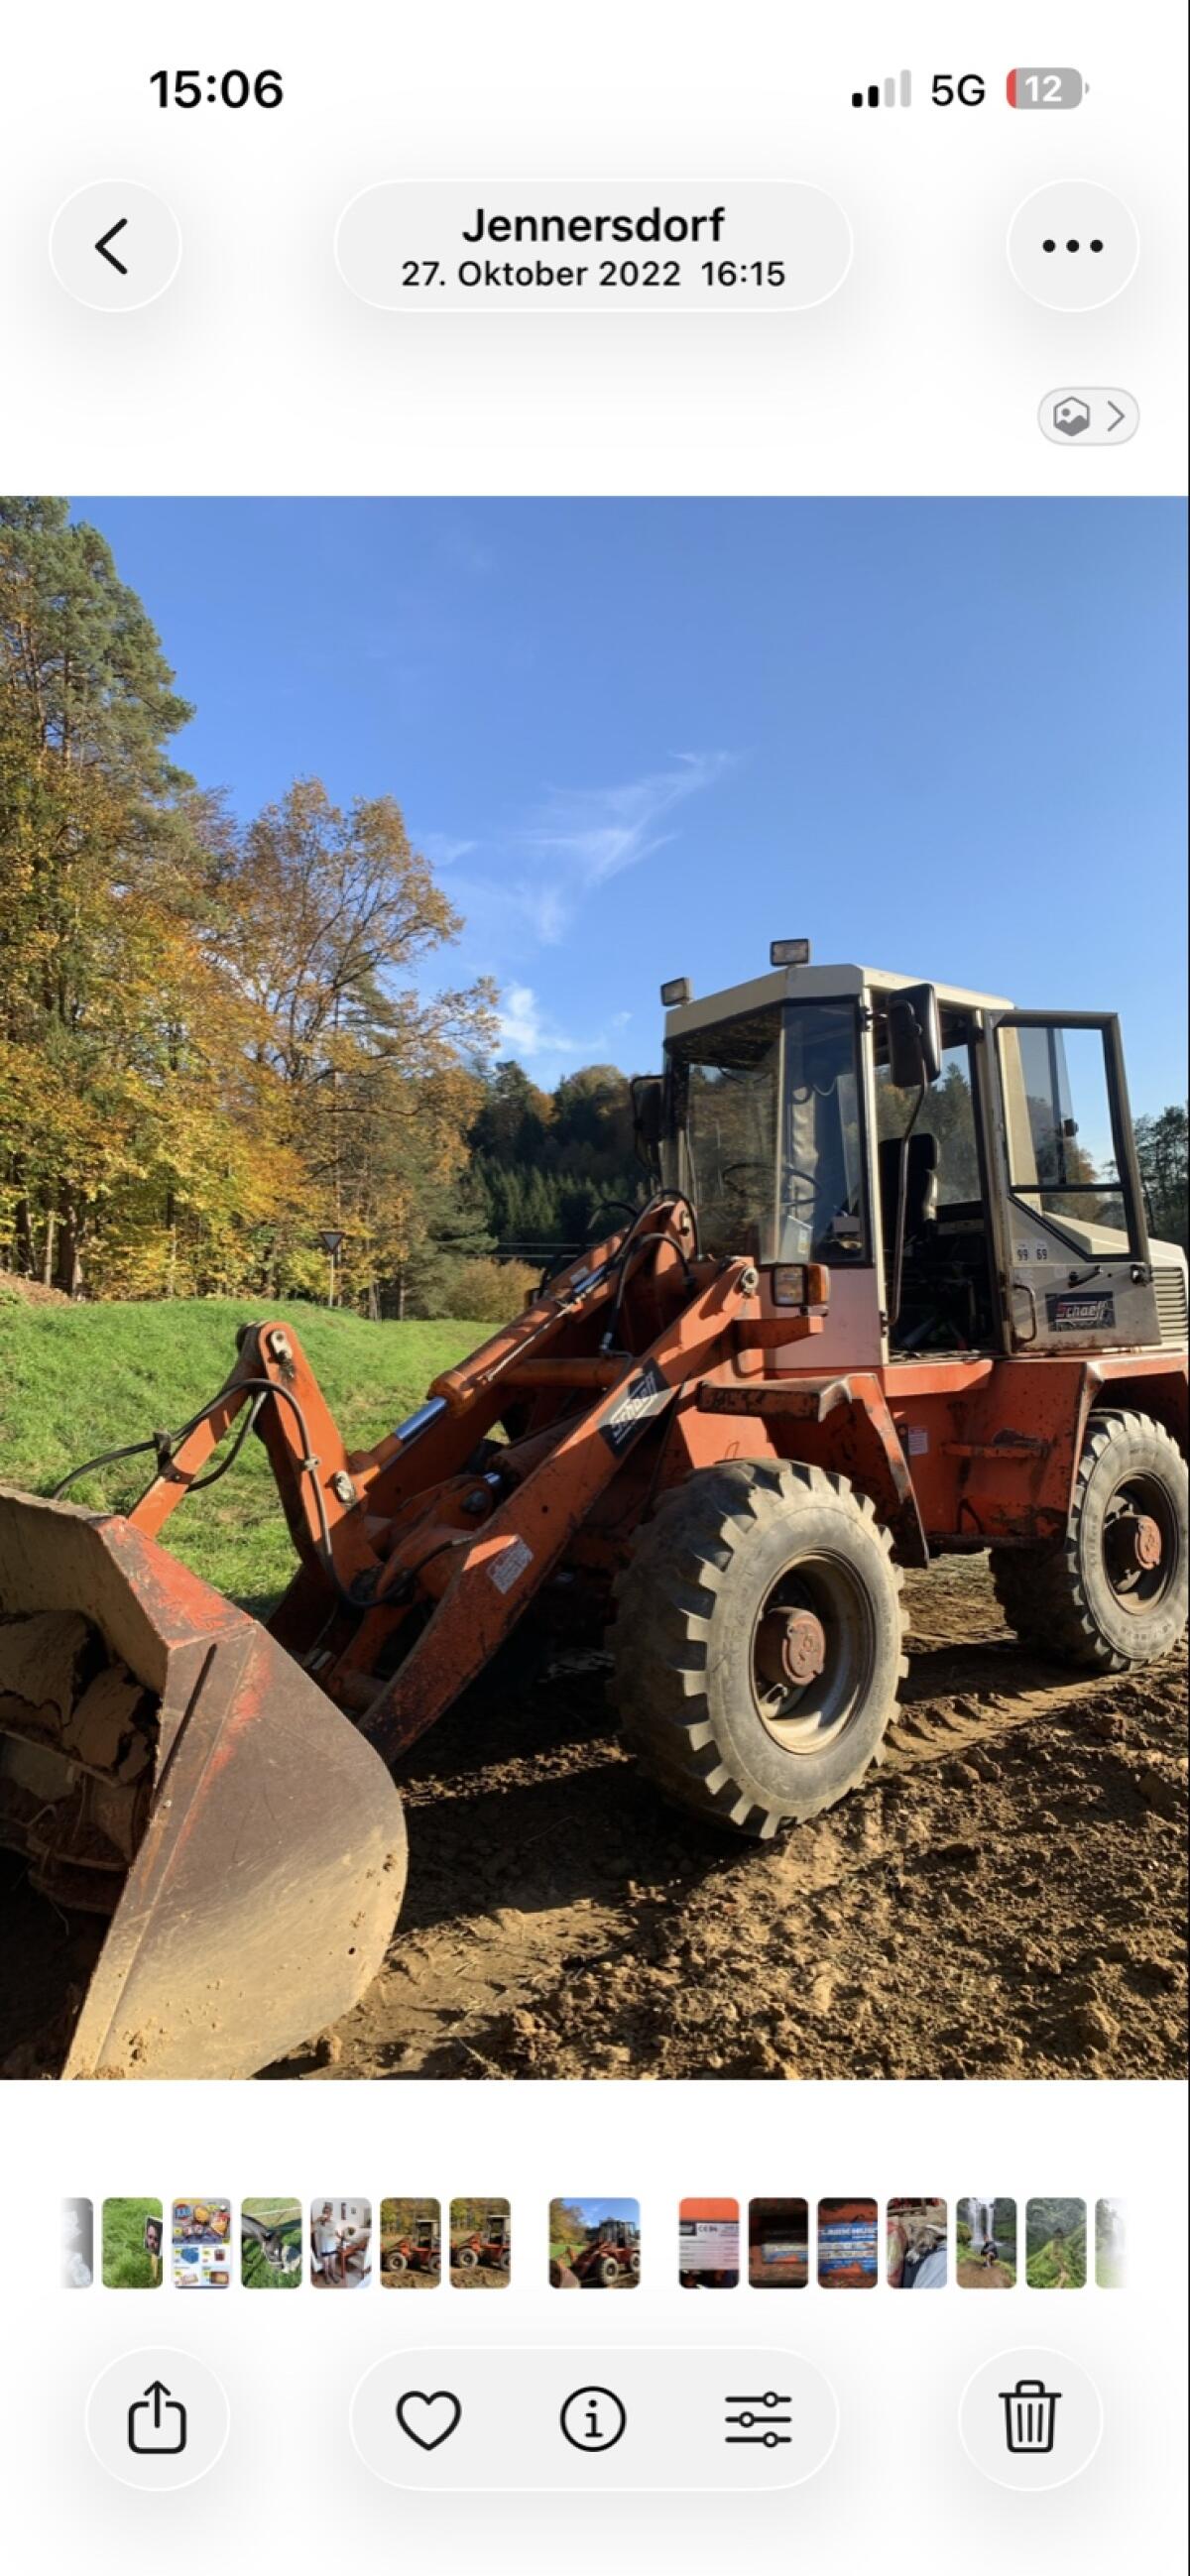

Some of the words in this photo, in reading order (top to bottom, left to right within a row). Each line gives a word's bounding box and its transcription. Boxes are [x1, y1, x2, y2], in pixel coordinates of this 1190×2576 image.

[150, 68, 284, 109] 15:06
[931, 73, 986, 107] 5G
[1024, 74, 1062, 102] 12
[461, 205, 726, 243] Jennersdorf
[402, 260, 445, 287] 27.
[458, 260, 589, 288] Oktober
[599, 260, 680, 288] 2022
[701, 260, 785, 288] 16:15
